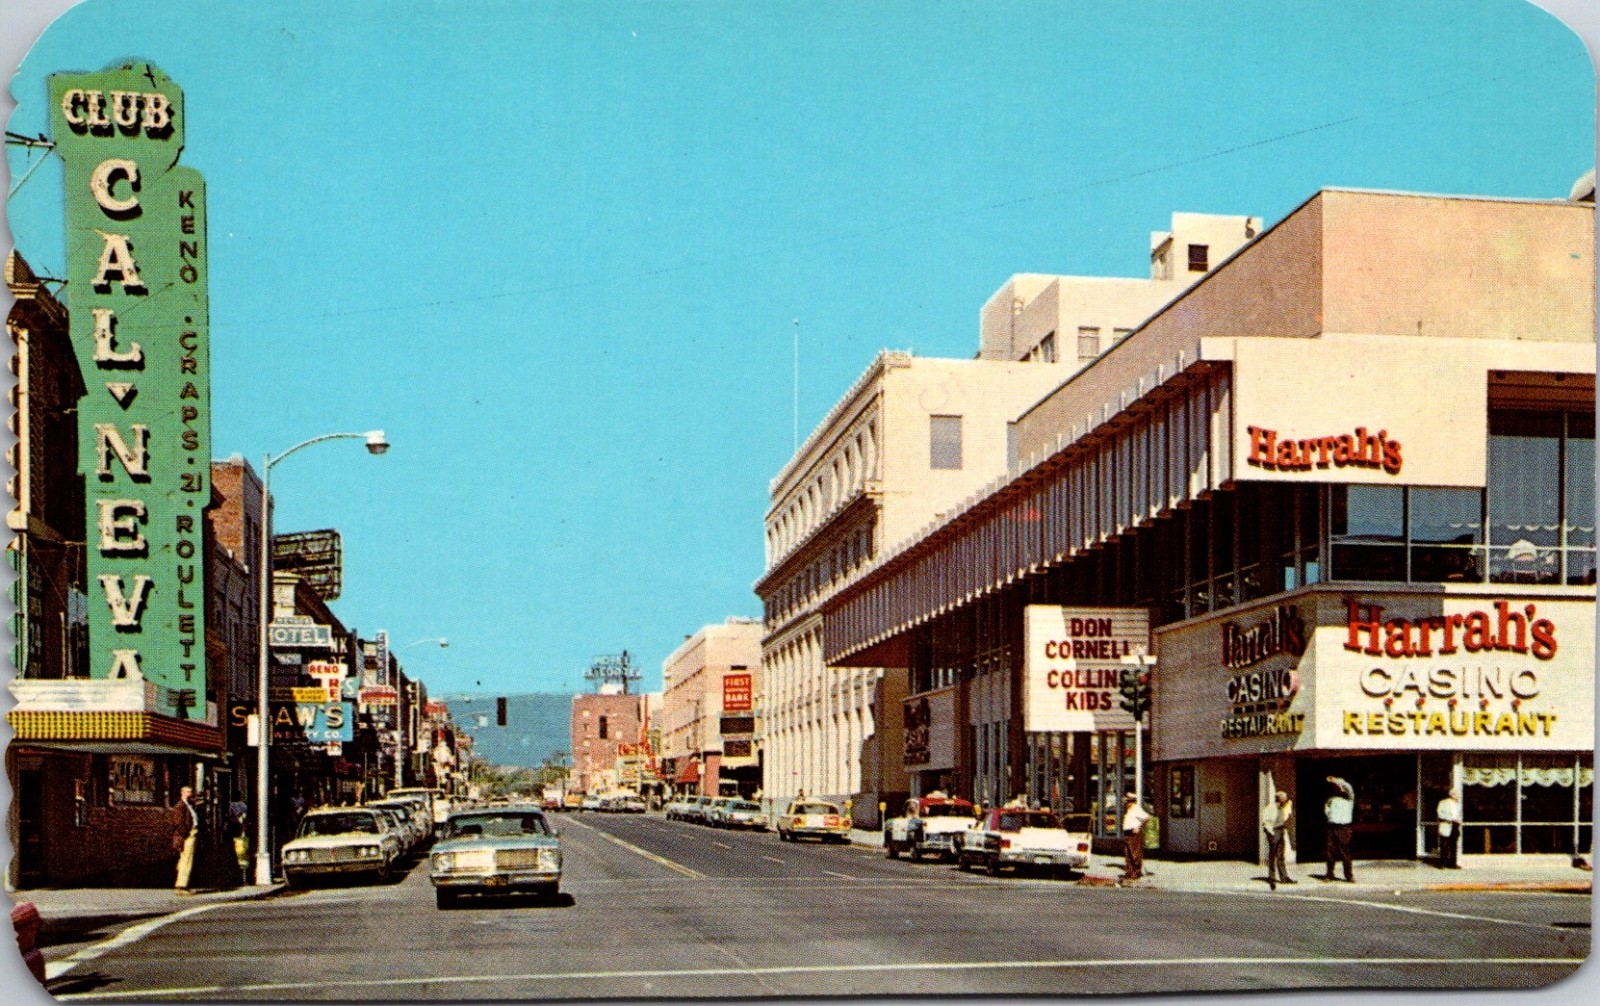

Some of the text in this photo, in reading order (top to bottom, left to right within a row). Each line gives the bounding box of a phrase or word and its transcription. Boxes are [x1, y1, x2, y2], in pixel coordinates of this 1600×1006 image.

[61, 88, 174, 136] CLUB
[178, 189, 198, 285] KENO
[178, 331, 200, 450] CRAPS
[1246, 424, 1403, 475] Harrah's
[176, 515, 196, 708] ROULETTE
[1071, 617, 1112, 638] DON
[1343, 598, 1557, 660] Harrah's
[308, 664, 340, 674] RENO
[725, 677, 750, 686] FIRST
[1359, 665, 1541, 699] CASINO
[725, 693, 750, 703] BANK
[1065, 690, 1113, 711] KIDS
[1343, 709, 1557, 738] RESTAURANT
